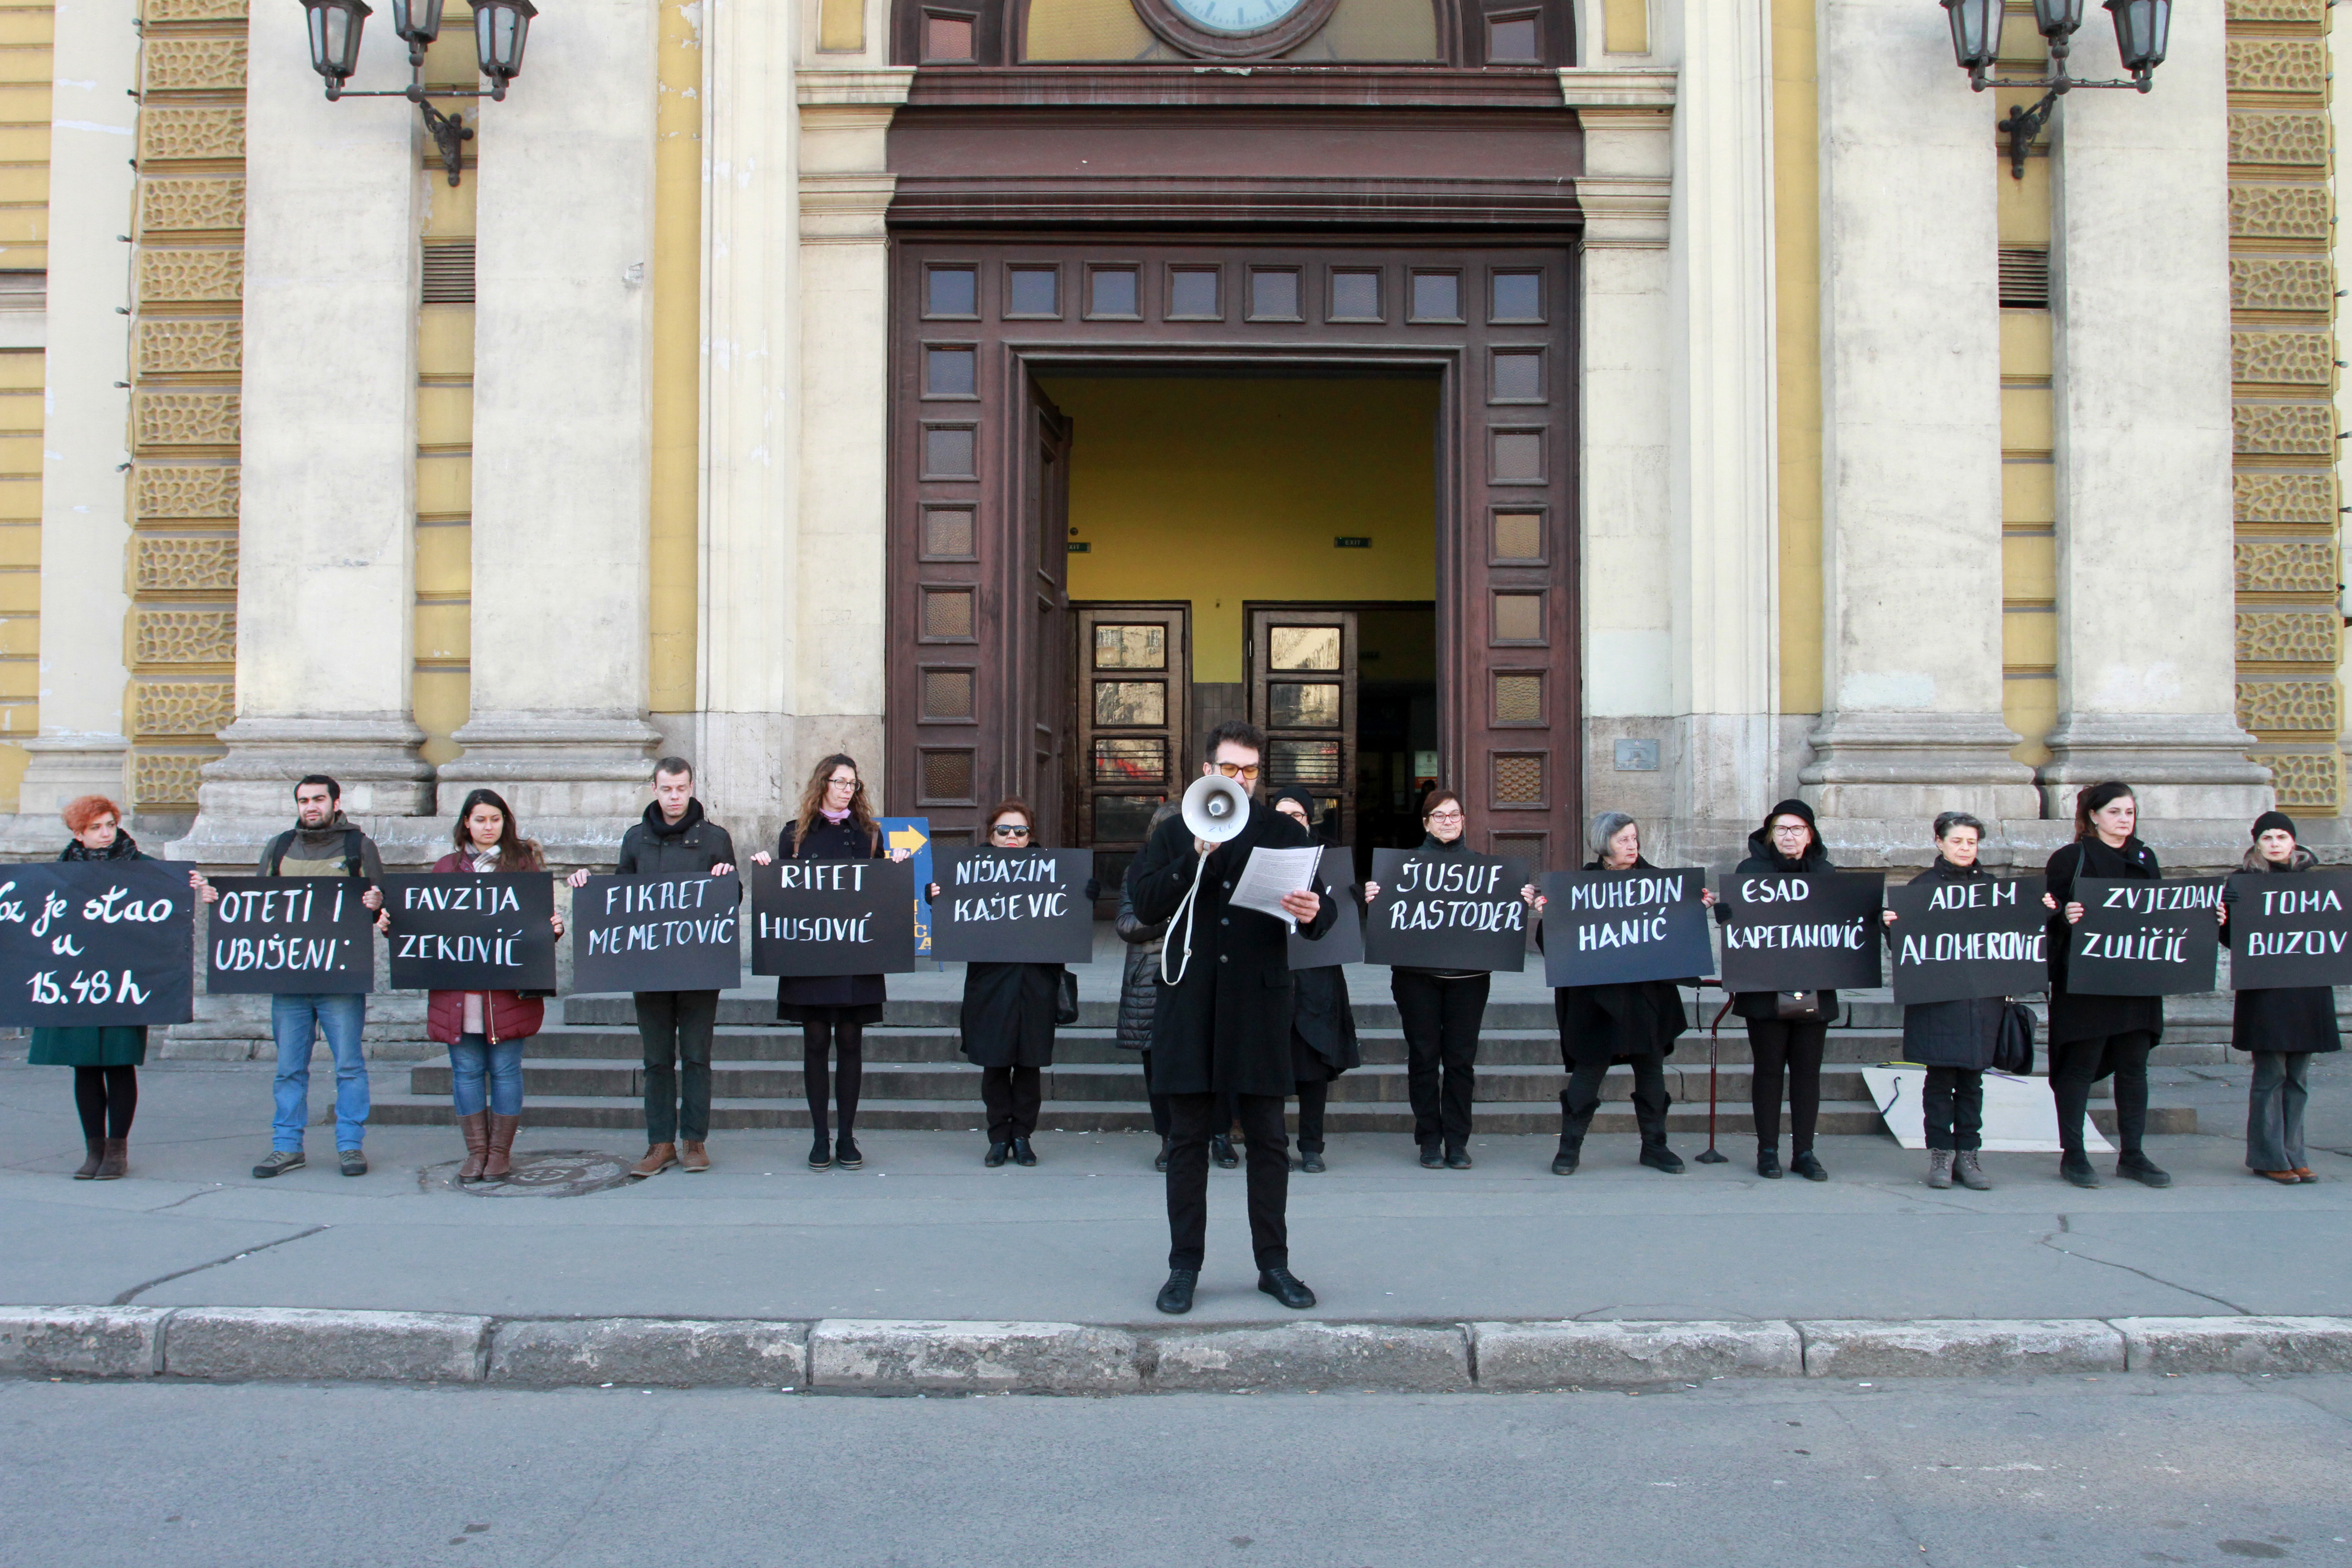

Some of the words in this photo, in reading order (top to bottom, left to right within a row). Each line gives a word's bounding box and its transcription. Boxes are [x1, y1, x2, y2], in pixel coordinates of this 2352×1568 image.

[955, 853, 1056, 886] NIJAZIM
[1396, 857, 1503, 894] JUSUF
[219, 882, 313, 923] OTETI
[405, 879, 520, 916] FAVZIJA
[606, 878, 713, 915] FIKRET
[954, 884, 1068, 922] KAJEVIĆ
[1571, 875, 1683, 911] MUHEDIN
[1741, 878, 1809, 903] ESAD
[1928, 882, 2016, 911] ADEM
[2102, 884, 2224, 914] ZVJEZDAN
[2261, 889, 2343, 916] TOMA
[31, 890, 68, 937] je
[82, 885, 174, 923] stao
[760, 911, 874, 943] HUSOVIĆ
[1388, 899, 1524, 932] RASTODER
[1579, 906, 1667, 951] HANIĆ
[51, 934, 85, 956] u
[397, 928, 524, 966] ZEKOVIĆ
[588, 906, 735, 956] MEMETOVIĆ
[1726, 916, 1866, 951] KAPETANOVIĆ
[1900, 925, 2048, 966] ALOMEROVIĆ
[2080, 926, 2189, 963] ZULIČIĆ
[2248, 930, 2348, 956] BUZOV
[215, 933, 351, 971] UBIJENI:
